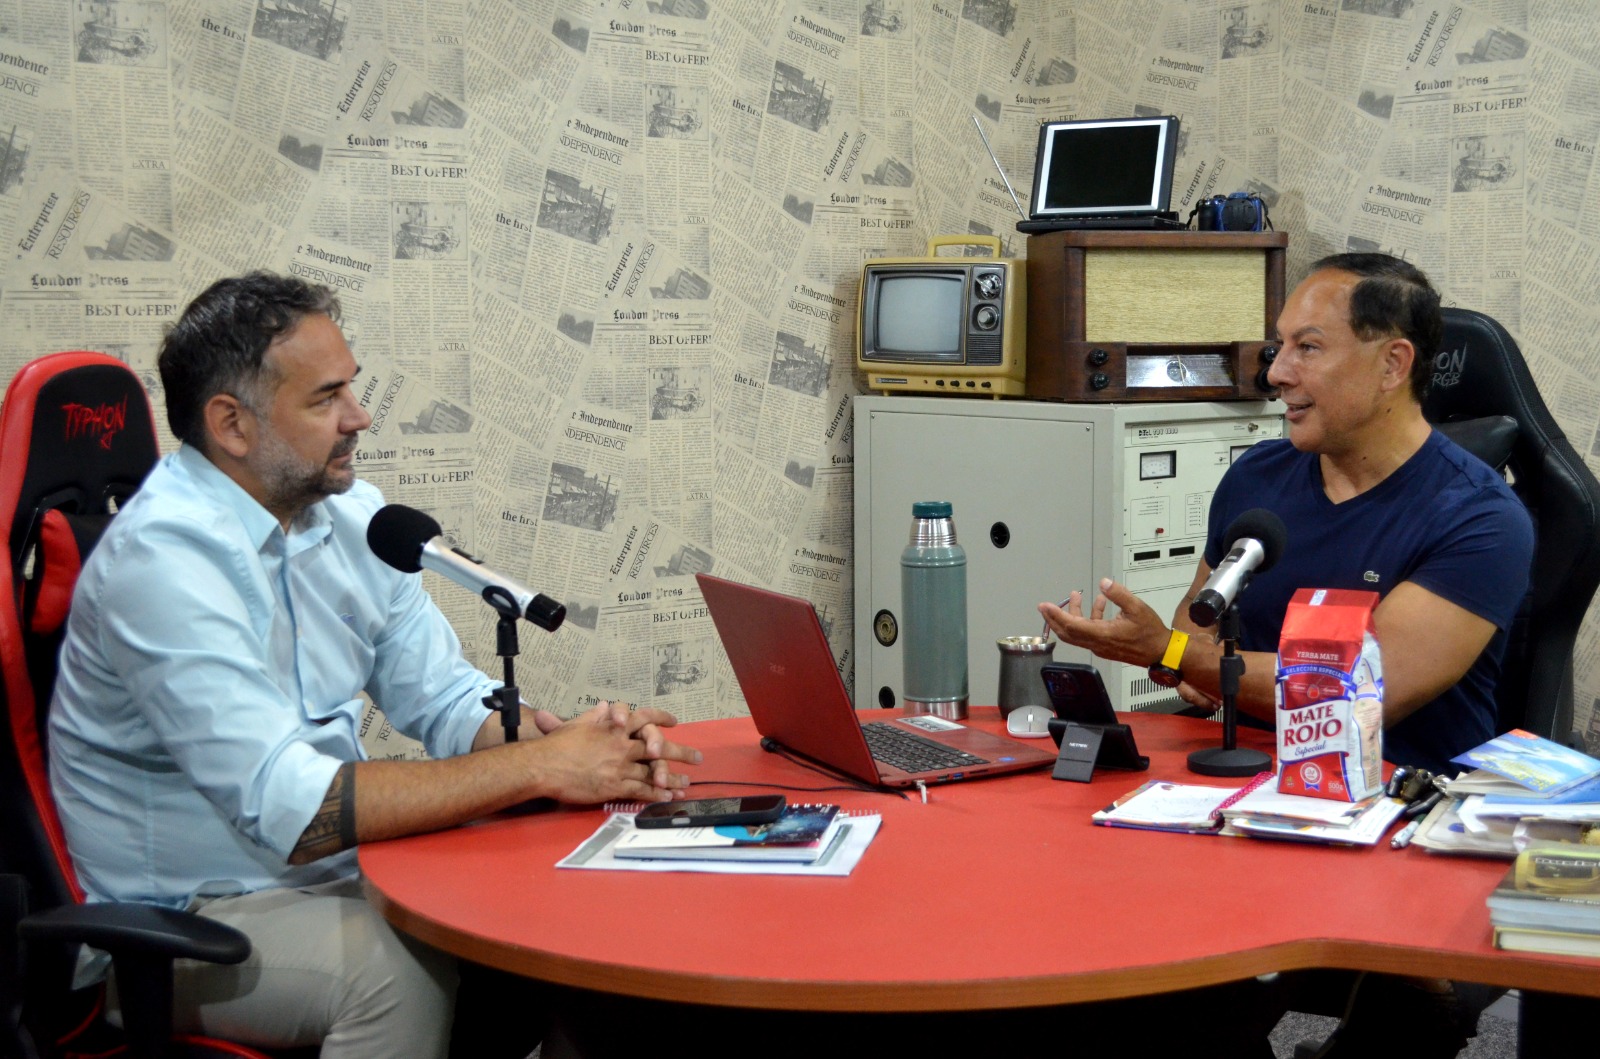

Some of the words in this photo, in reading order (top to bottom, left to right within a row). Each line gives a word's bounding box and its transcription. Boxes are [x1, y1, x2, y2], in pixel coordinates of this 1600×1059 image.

[1304, 3, 1319, 15] the
[201, 17, 220, 34] the
[609, 19, 645, 35] London
[1428, 6, 1463, 68] RESOURCES
[645, 49, 672, 63] BEST
[361, 61, 398, 122] RESOURCES
[1415, 78, 1453, 92] London
[732, 97, 746, 113] the
[1452, 100, 1481, 115] BEST
[347, 133, 389, 149] London
[1555, 137, 1572, 150] the
[843, 131, 867, 183] RESOURCES
[391, 164, 421, 178] BEST
[830, 193, 860, 206] London
[48, 191, 91, 260] RESOURCES
[496, 213, 511, 226] the
[860, 217, 882, 229] BEST
[626, 242, 655, 298] RESOURCES
[30, 274, 82, 289] London
[85, 304, 121, 317] BEST
[613, 309, 648, 321] London
[649, 334, 672, 345] BEST
[734, 373, 748, 385] the
[370, 374, 405, 436] RESOURCES
[61, 393, 128, 442] TYPHON
[355, 446, 396, 463] London
[399, 473, 428, 485] BEST
[502, 511, 517, 522] the
[630, 523, 659, 579] RESOURCES
[618, 591, 651, 605] London
[653, 611, 677, 623] BEST
[1297, 651, 1319, 659] YERBA
[1319, 667, 1345, 678] ESPECIAL
[1289, 704, 1334, 725] MATE
[1284, 718, 1342, 747] ROJO
[1295, 740, 1327, 757] Especial
